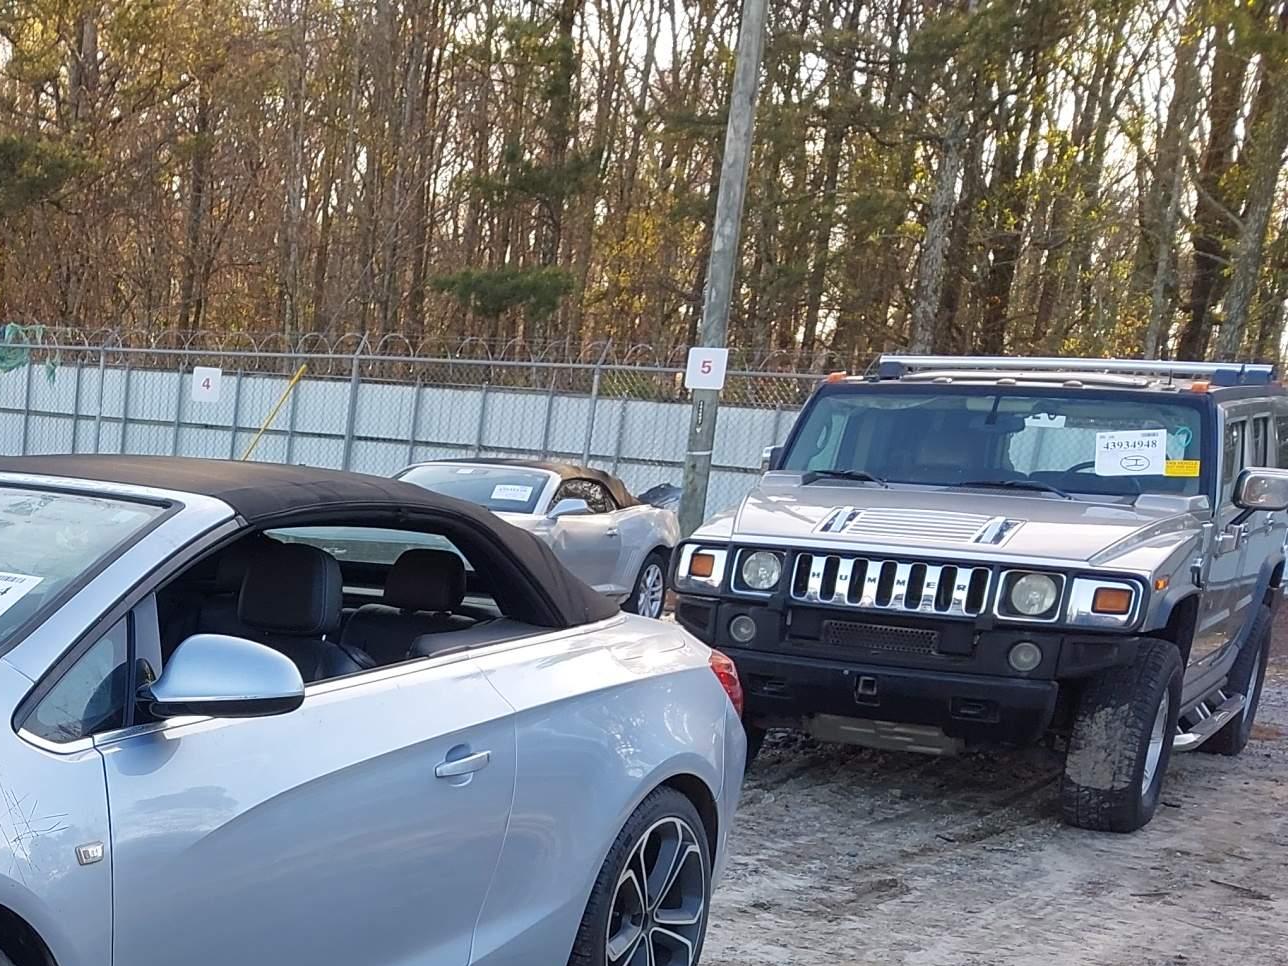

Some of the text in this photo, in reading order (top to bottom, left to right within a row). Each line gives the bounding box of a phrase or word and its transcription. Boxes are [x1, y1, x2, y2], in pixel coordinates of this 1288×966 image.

[700, 360, 713, 375] 5
[202, 377, 211, 390] 4
[1103, 439, 1158, 450] 43934948
[811, 571, 967, 592] HUMMER
